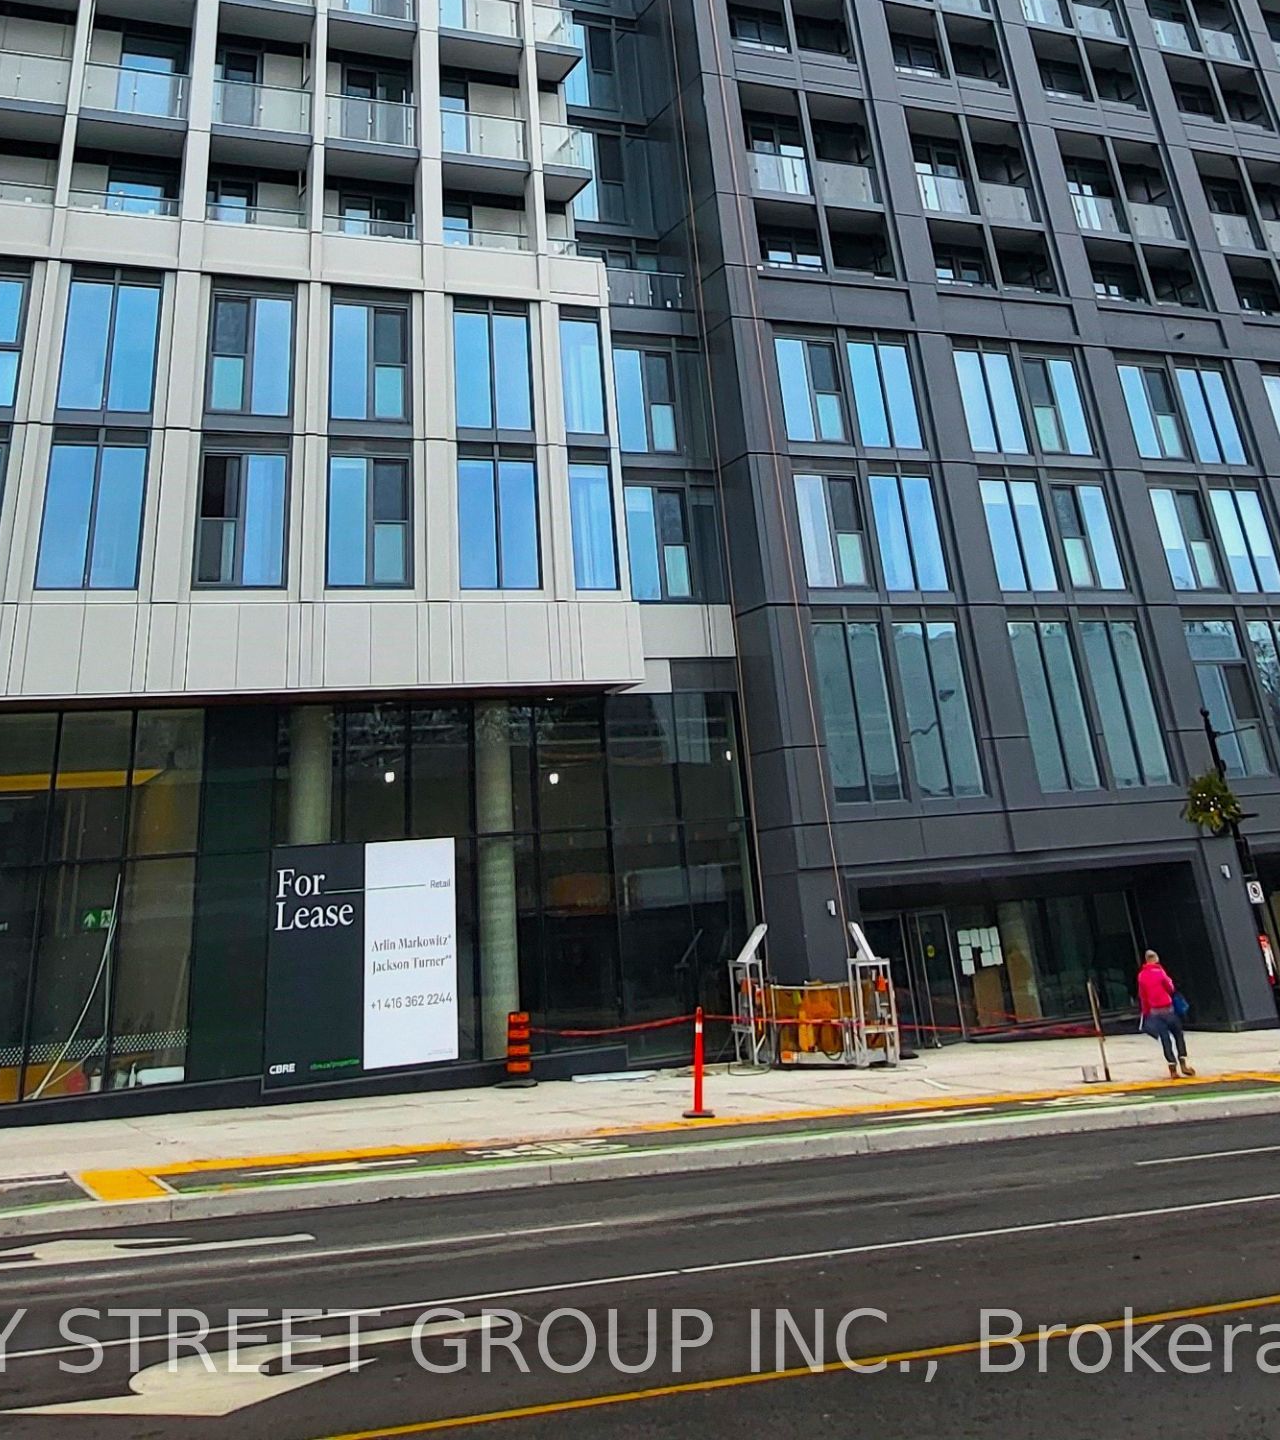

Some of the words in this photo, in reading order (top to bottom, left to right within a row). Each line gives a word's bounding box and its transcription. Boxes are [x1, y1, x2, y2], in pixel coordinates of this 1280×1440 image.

[276, 868, 326, 899] For
[429, 878, 451, 889] Retail
[274, 901, 355, 932] Lease
[371, 939, 396, 952] Arlin
[372, 958, 410, 975] Jackson
[371, 999, 382, 1011] +1
[384, 996, 403, 1009] 416
[405, 994, 425, 1008] 362
[426, 991, 453, 1006] 2244
[269, 1062, 296, 1075] CBRE
